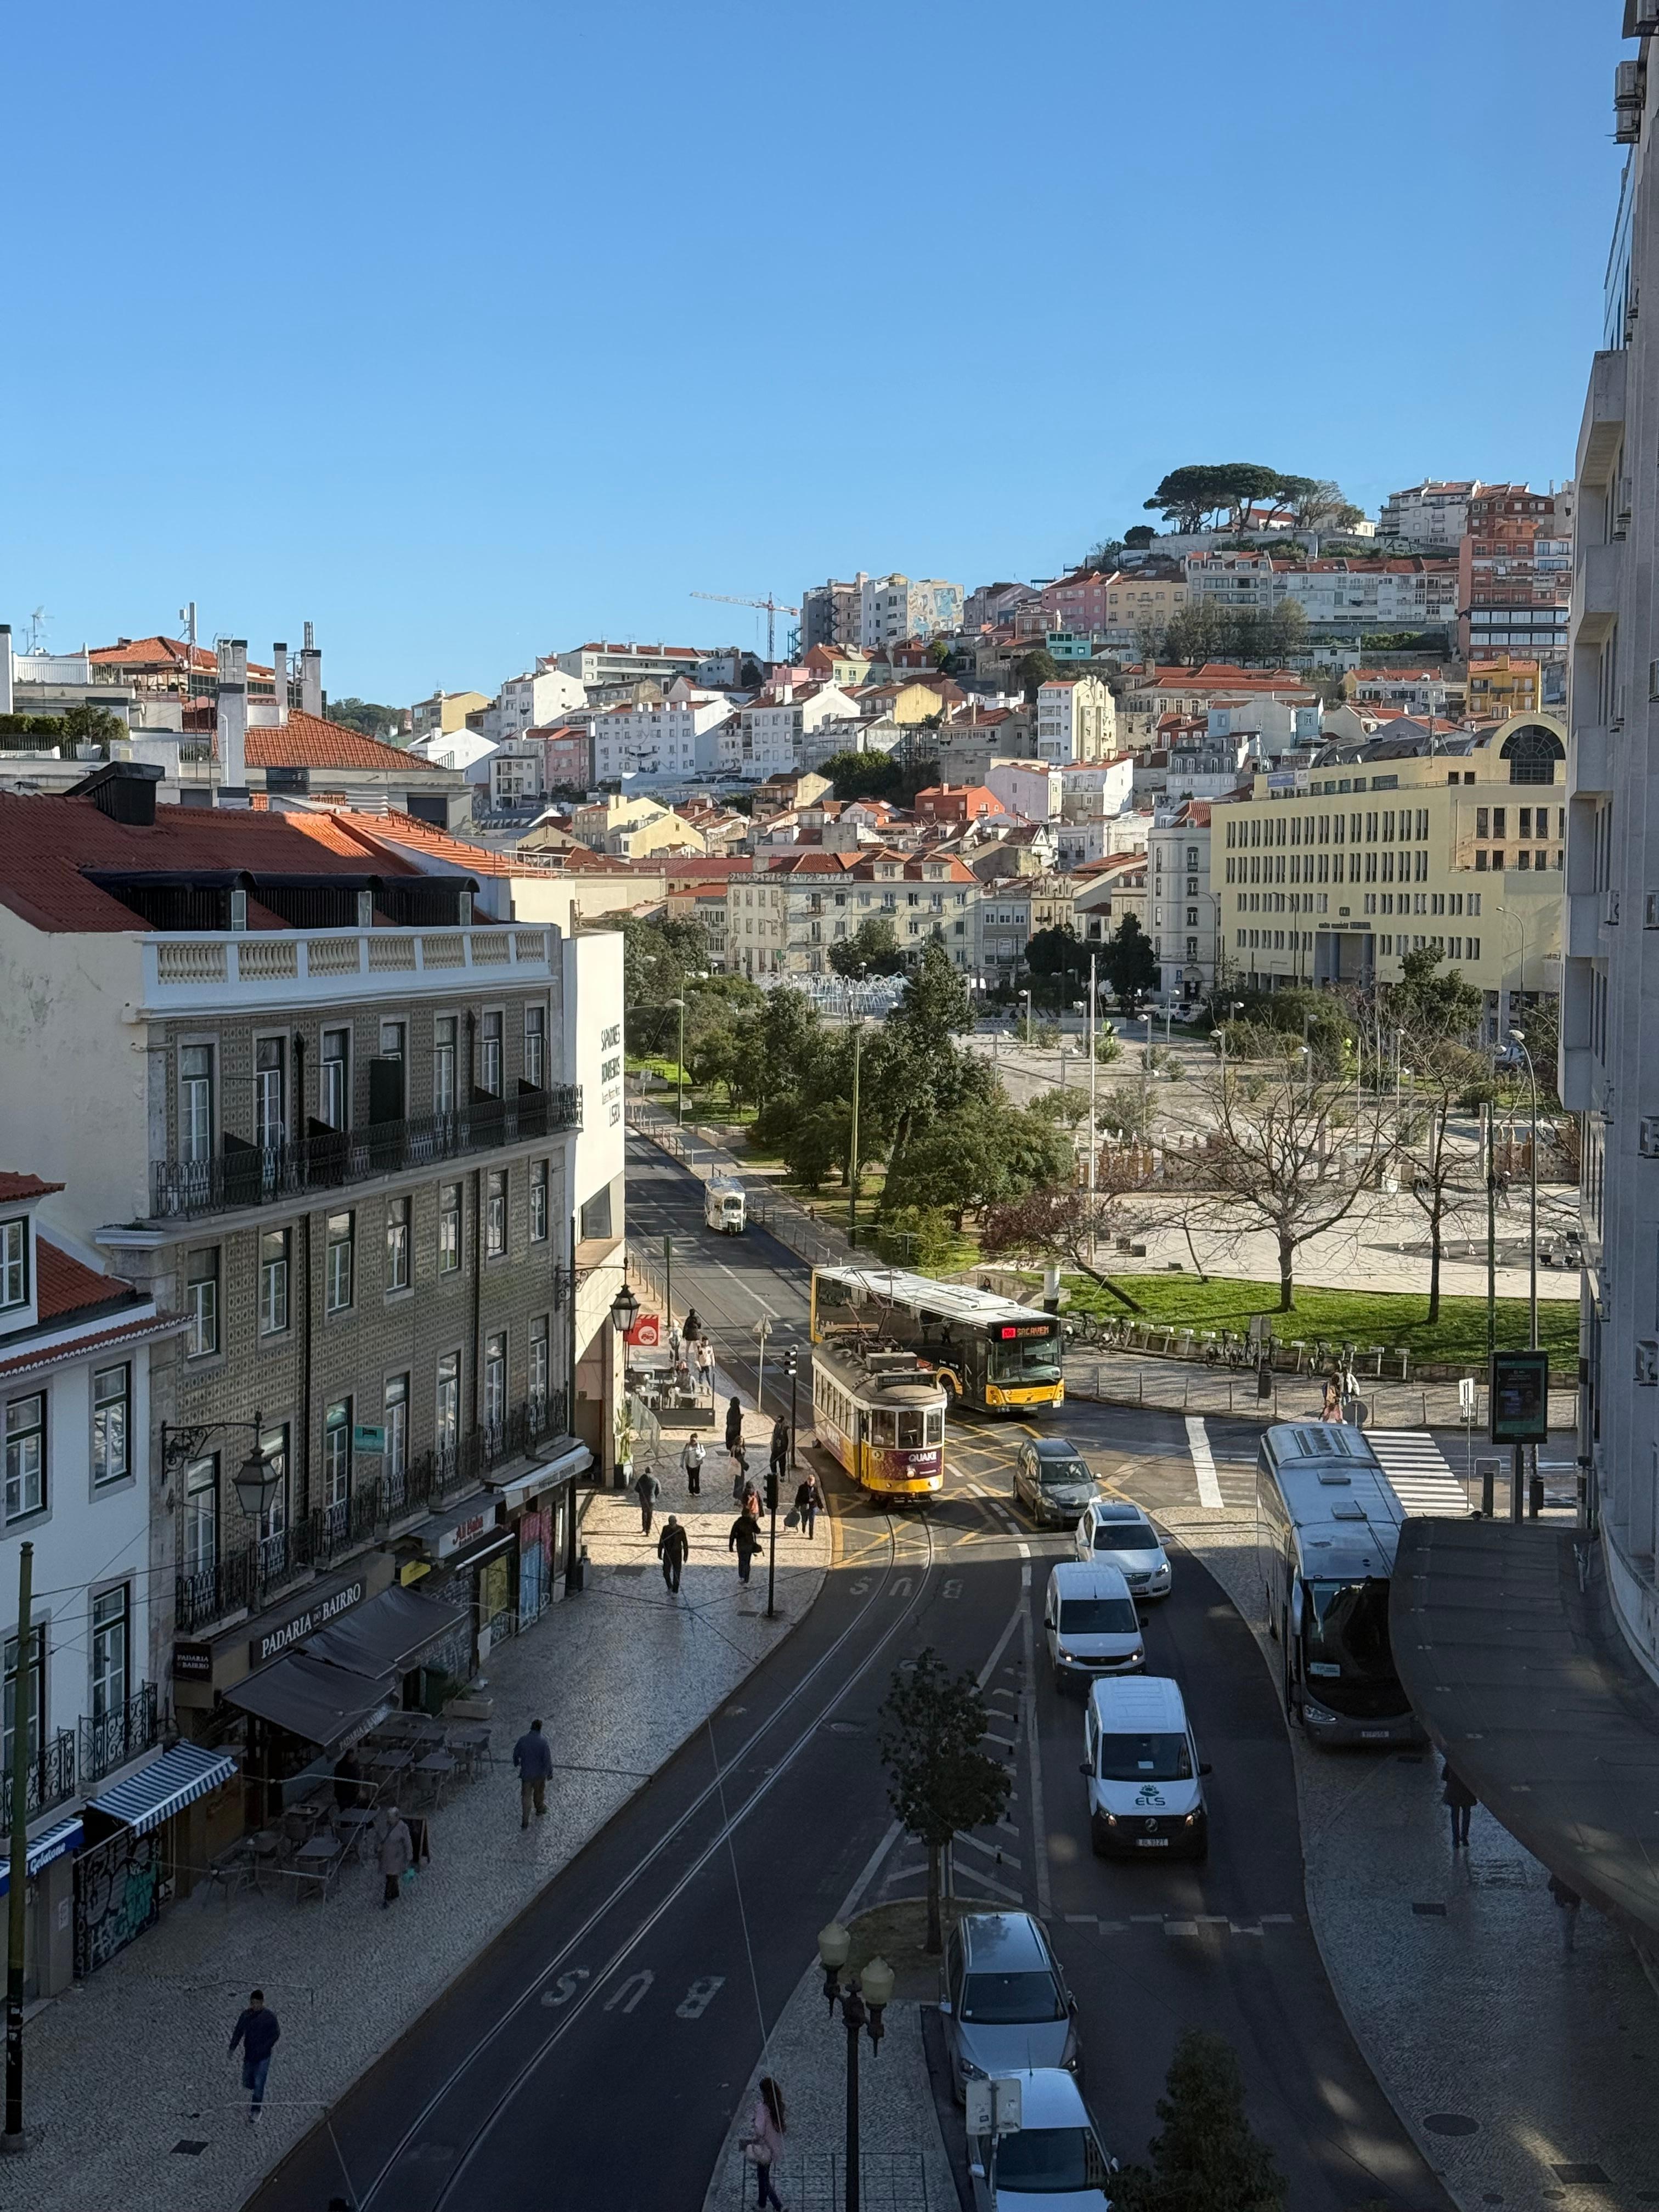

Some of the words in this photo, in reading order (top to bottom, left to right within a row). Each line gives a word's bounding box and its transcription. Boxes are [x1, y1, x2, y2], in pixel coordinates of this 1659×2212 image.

[909, 1451, 937, 1462] QUAKE
[261, 1613, 312, 1660] PADARIA
[322, 1583, 361, 1621] BAIRRO
[177, 1654, 209, 1662] PADARIA
[1135, 1797, 1166, 1806] ELS
[540, 1965, 727, 2019] BUS
